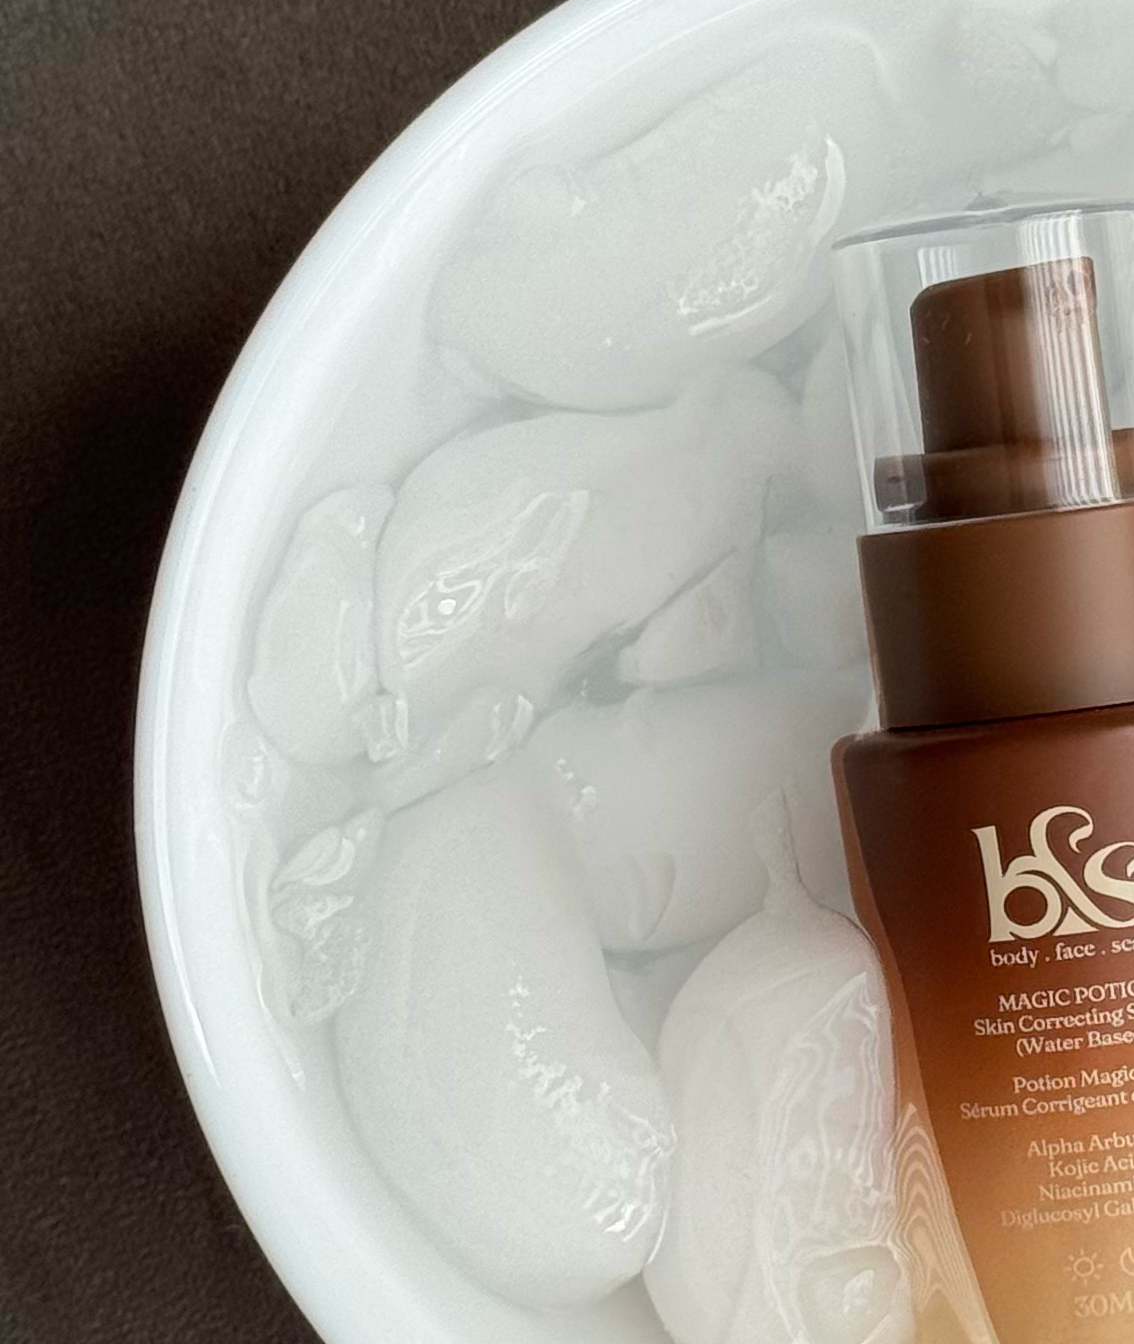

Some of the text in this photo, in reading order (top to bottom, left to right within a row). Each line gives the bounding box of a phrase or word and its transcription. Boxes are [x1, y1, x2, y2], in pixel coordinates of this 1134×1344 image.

[990, 946, 1040, 968] body
[1055, 941, 1096, 961] face
[998, 988, 1071, 1012] MAGIC
[974, 1016, 1015, 1036] Skin
[1018, 1007, 1124, 1032] Correcting
[1016, 1034, 1084, 1057] (Water
[1013, 1075, 1076, 1094] Potion
[960, 1100, 1019, 1120] Sérum
[1022, 1091, 1129, 1115] Corrigeant
[1027, 1138, 1084, 1160] Alpha
[1049, 1159, 1100, 1181] Kojic
[1001, 1204, 1100, 1231] Diglucosyl
